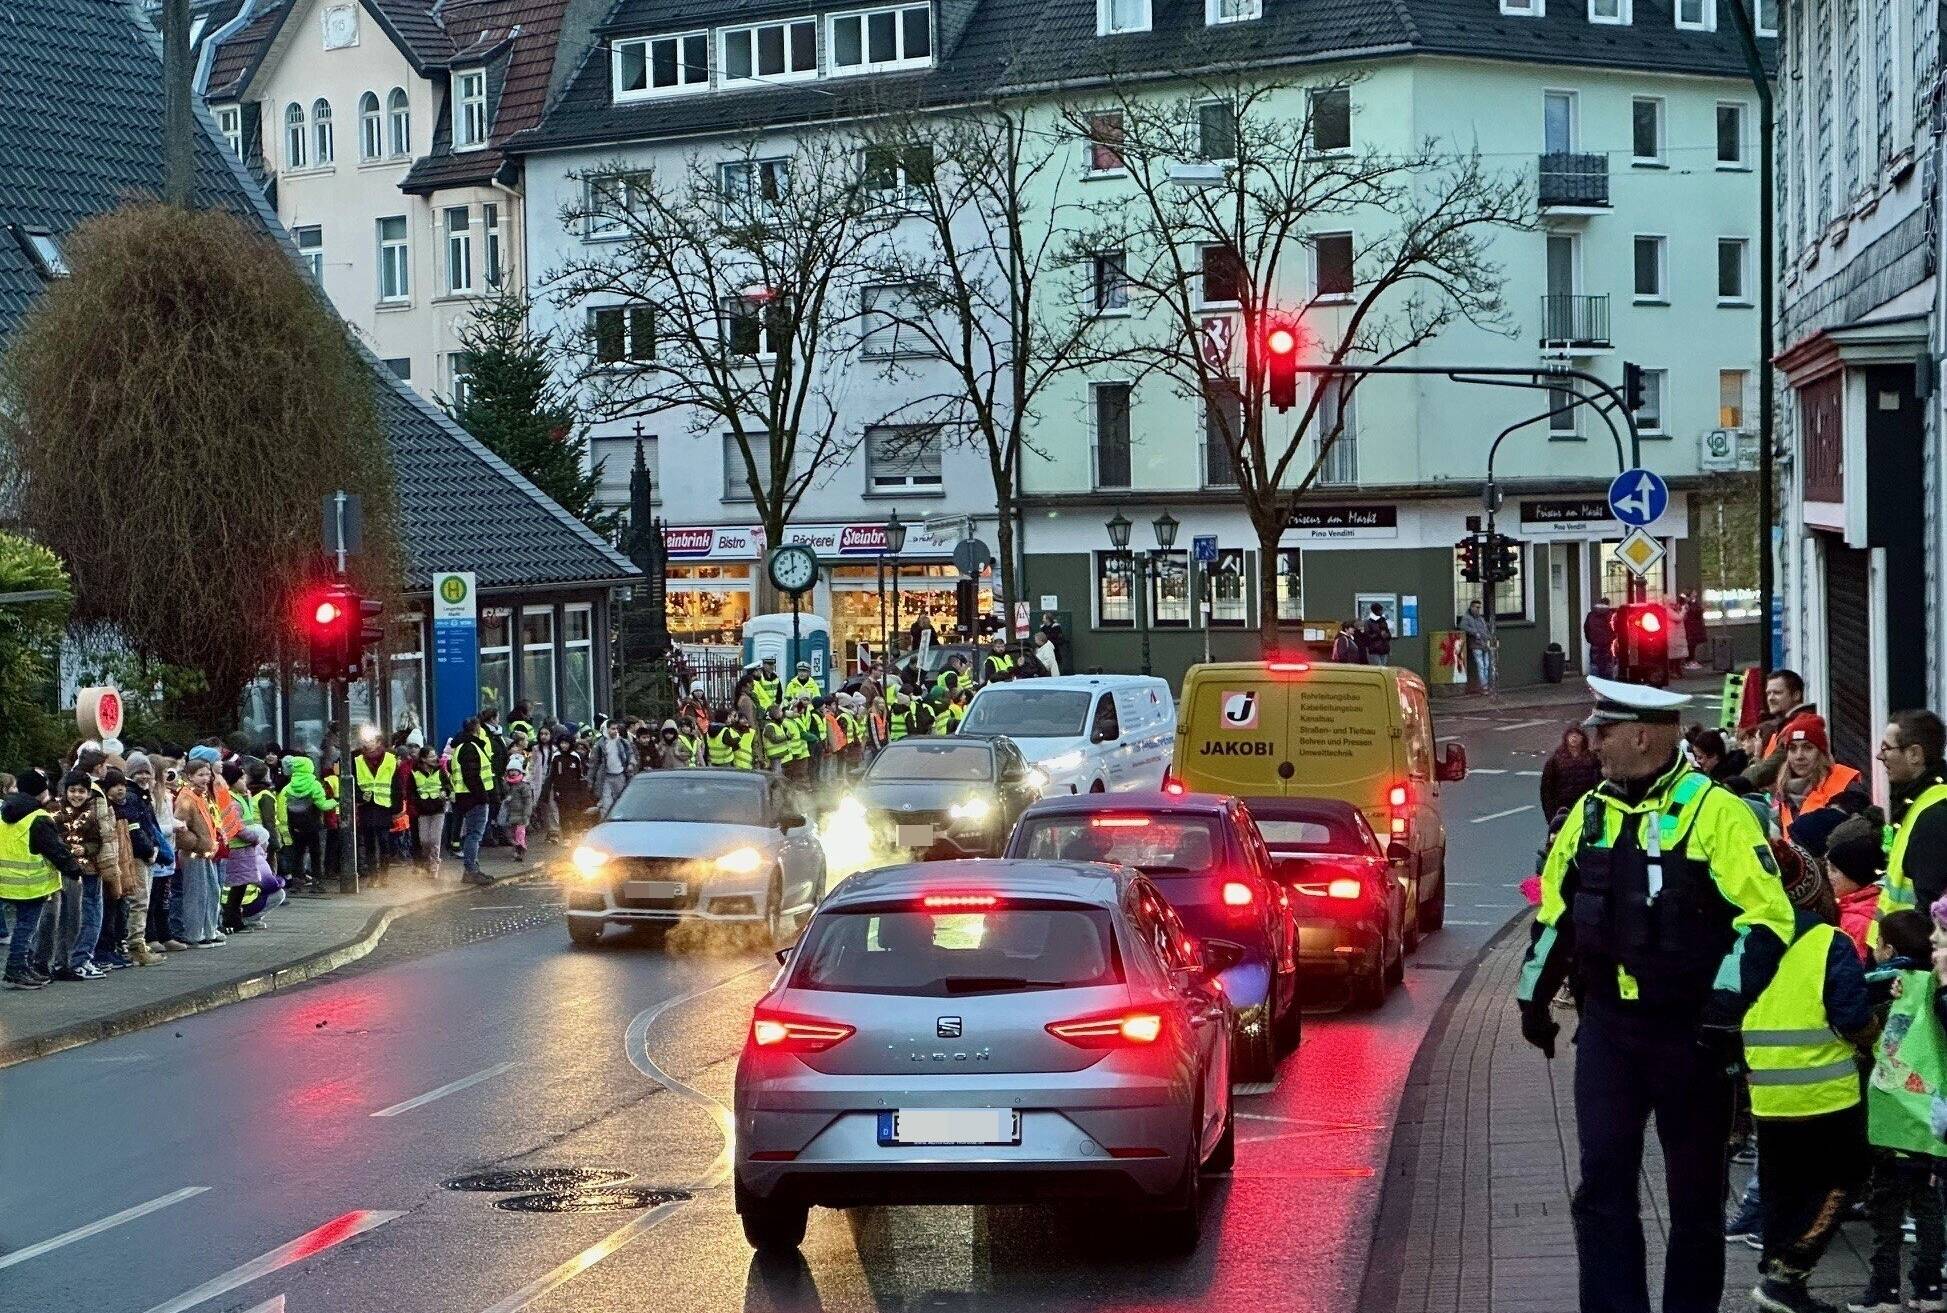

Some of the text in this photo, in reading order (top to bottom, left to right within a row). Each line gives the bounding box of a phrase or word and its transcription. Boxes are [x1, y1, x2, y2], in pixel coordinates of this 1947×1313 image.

[1327, 515, 1342, 524] am
[1348, 510, 1377, 524] Markt
[1328, 529, 1355, 537] Venditti
[718, 536, 746, 549] Bistro
[447, 581, 459, 598] H
[1333, 726, 1347, 734] und
[1349, 726, 1376, 735] Tiefbau
[1300, 737, 1373, 746] Bohren und Pressen
[1200, 741, 1274, 756] JAKOBI
[1299, 748, 1353, 757] Umwelttechnik
